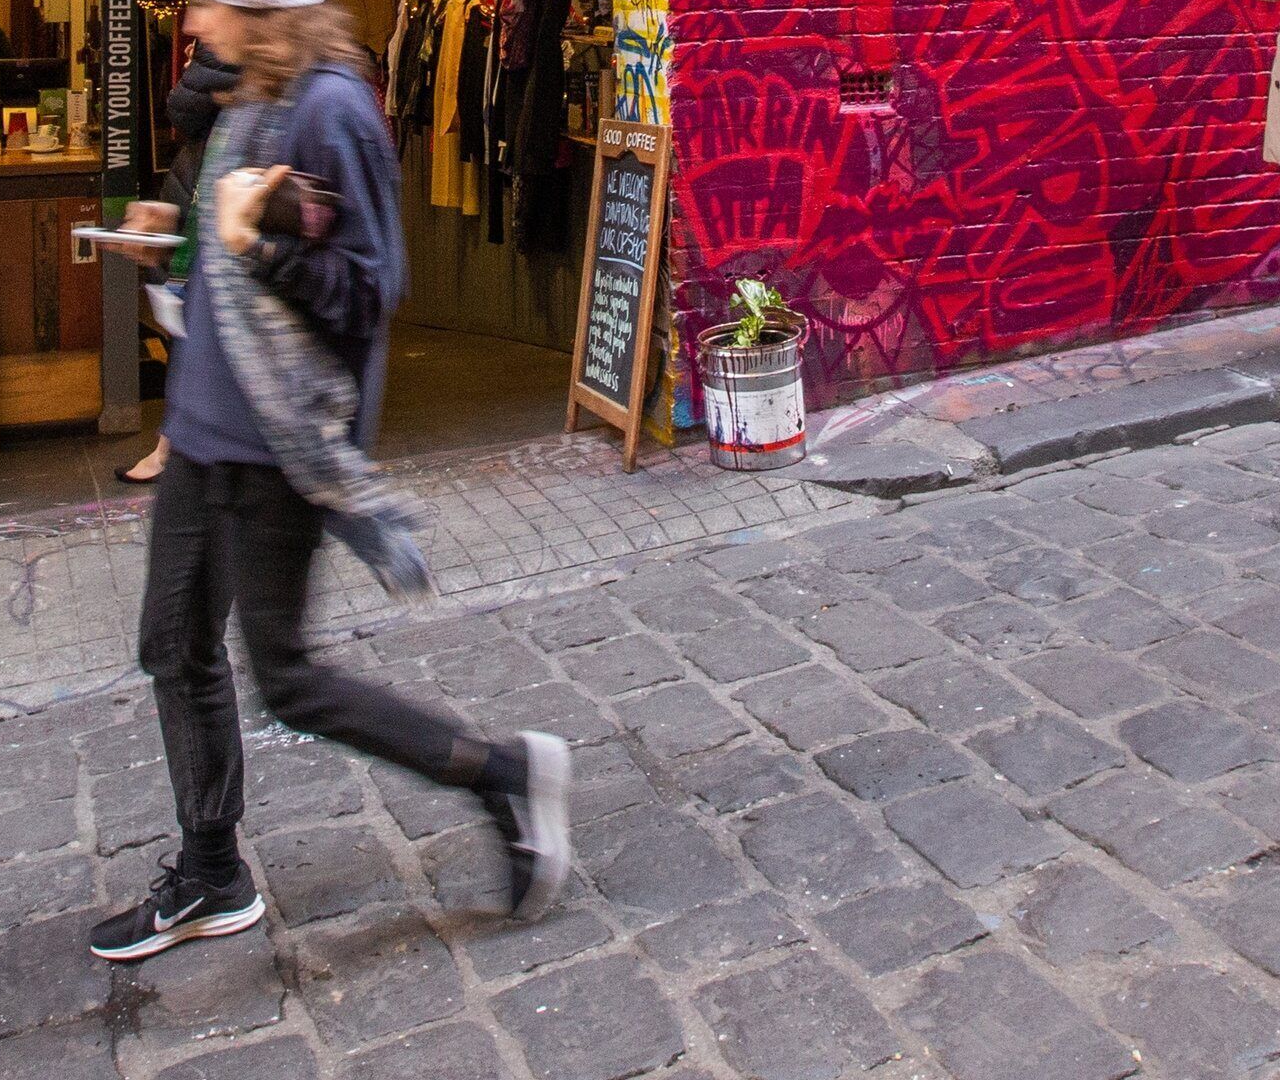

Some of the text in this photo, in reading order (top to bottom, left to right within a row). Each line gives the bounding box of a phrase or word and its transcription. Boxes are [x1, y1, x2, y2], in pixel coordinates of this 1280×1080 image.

[108, 63, 131, 120] YOUR
[108, 122, 131, 169] WHY
[625, 132, 656, 152] COFFEE
